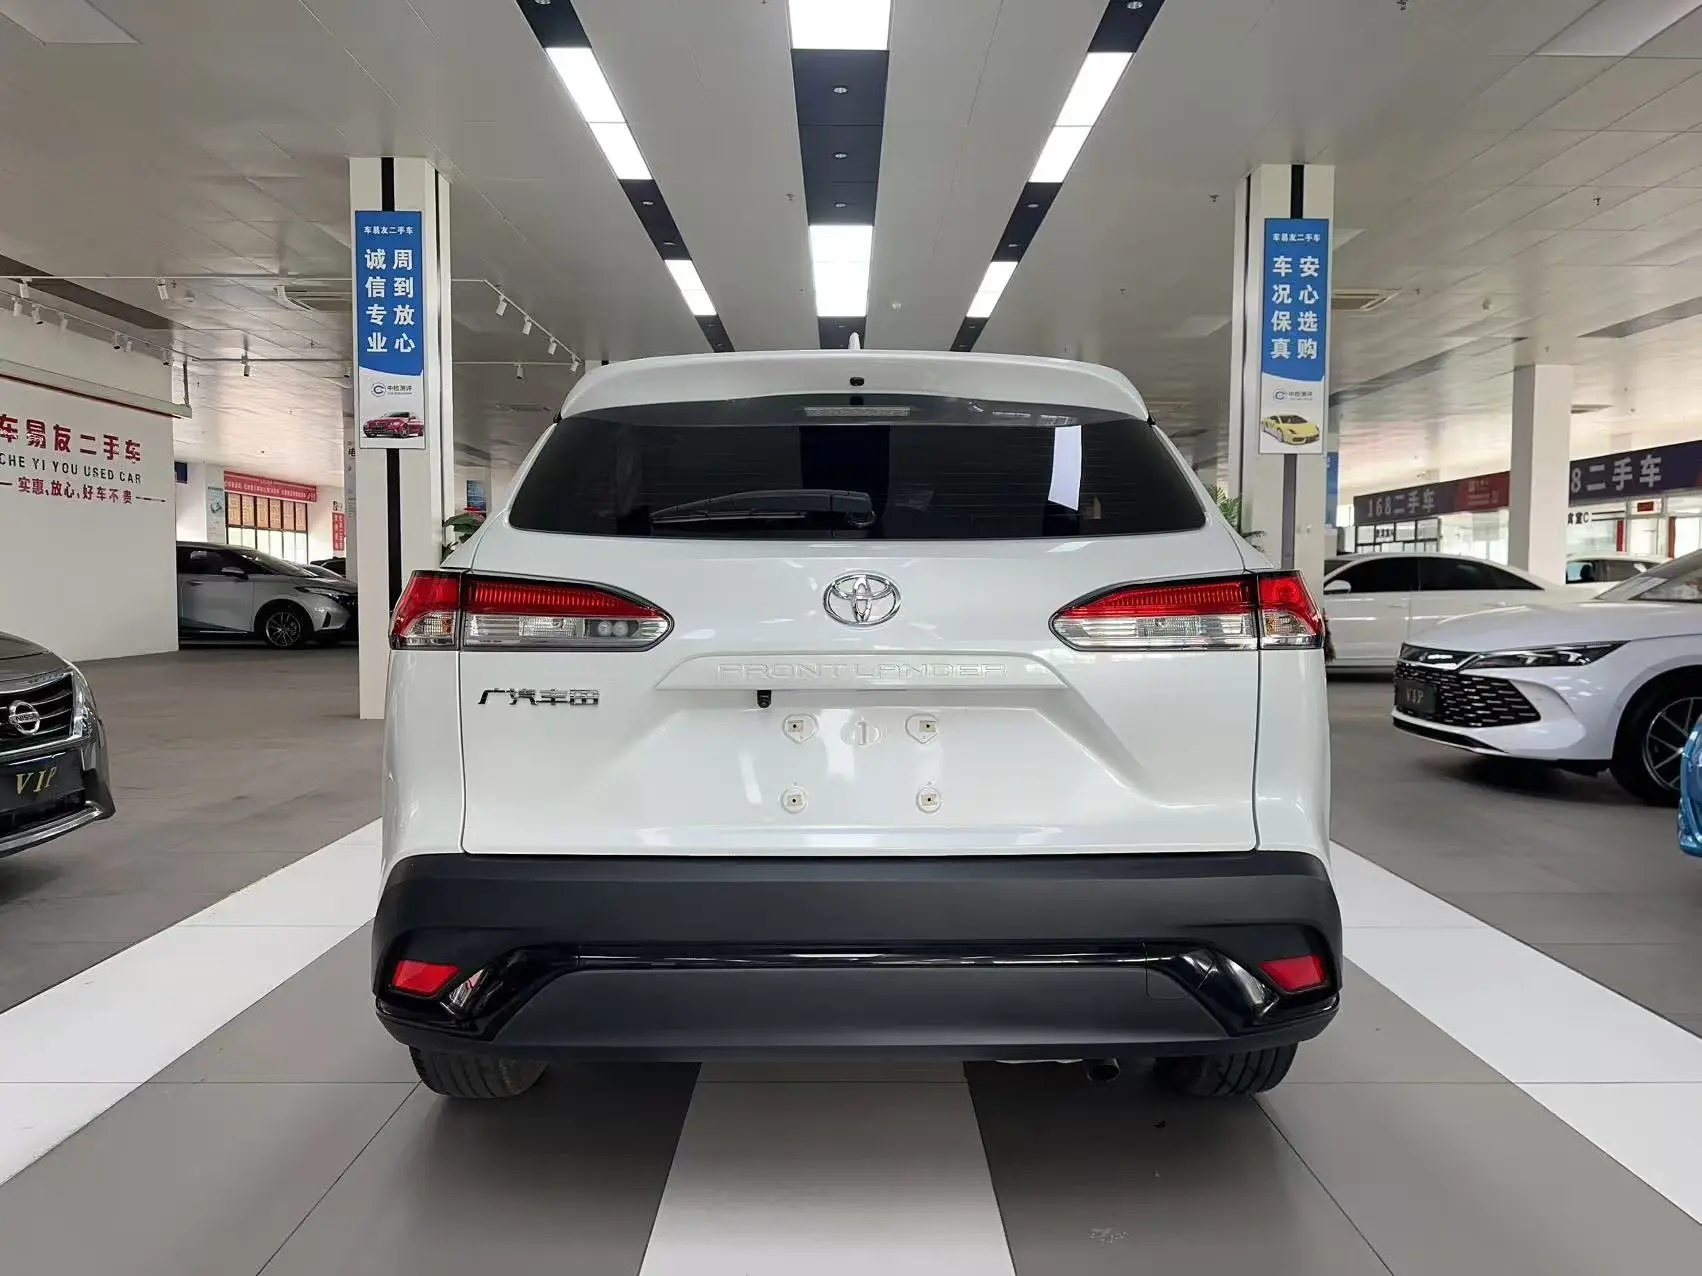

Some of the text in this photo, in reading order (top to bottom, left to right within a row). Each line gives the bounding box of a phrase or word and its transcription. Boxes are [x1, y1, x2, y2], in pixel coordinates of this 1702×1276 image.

[363, 225, 414, 235] 车易友二手车
[364, 248, 388, 353] 诚信专业
[392, 249, 416, 353] 周到放心
[1270, 255, 1293, 359] 车况保真
[1296, 255, 1320, 360] 安心选购
[0, 413, 141, 462] 车易友二手车
[0, 453, 142, 484] CHE YI YOU USED CAR
[1367, 488, 1436, 518] 168二手车
[717, 662, 1008, 680] FRONTLANDER
[16, 765, 57, 795] VIP
